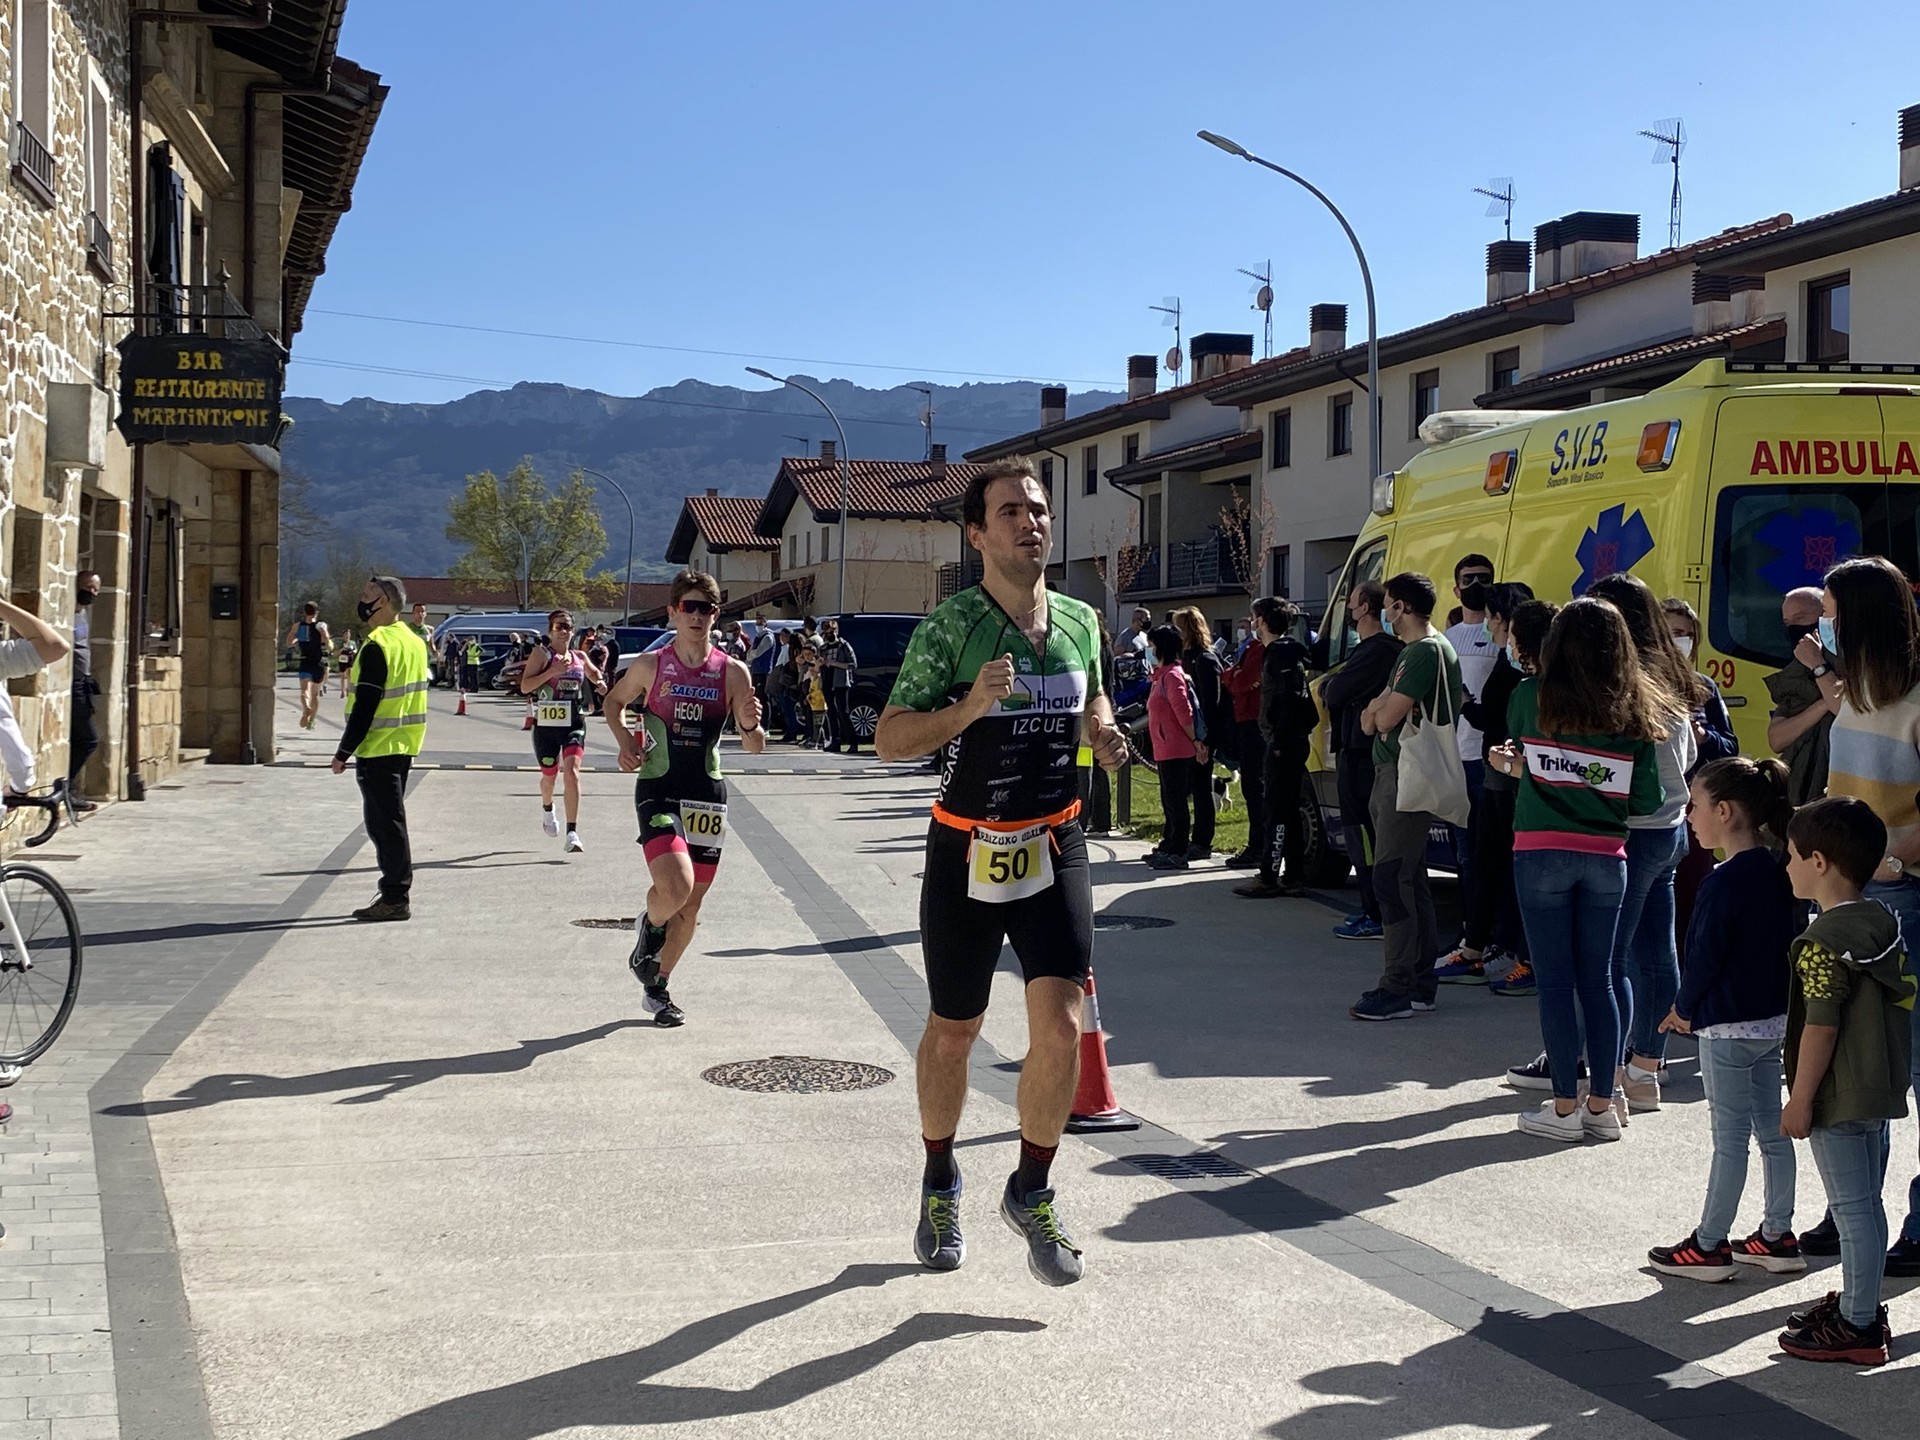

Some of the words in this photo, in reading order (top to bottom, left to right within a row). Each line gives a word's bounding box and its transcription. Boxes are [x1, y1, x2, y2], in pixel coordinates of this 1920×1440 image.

[176, 351, 224, 370] BAR
[133, 378, 266, 400] RESTAURANTE
[1550, 420, 1609, 476] S.V.B.
[1750, 440, 1920, 476] AMBULA
[1706, 659, 1736, 689] 29
[670, 685, 719, 701] SALTOKI
[541, 707, 566, 720] 103
[673, 702, 704, 721] HEGOI
[1012, 717, 1067, 735] IZCUE
[686, 812, 722, 836] 108
[1271, 823, 1285, 872] adidas
[988, 847, 1029, 884] 50
